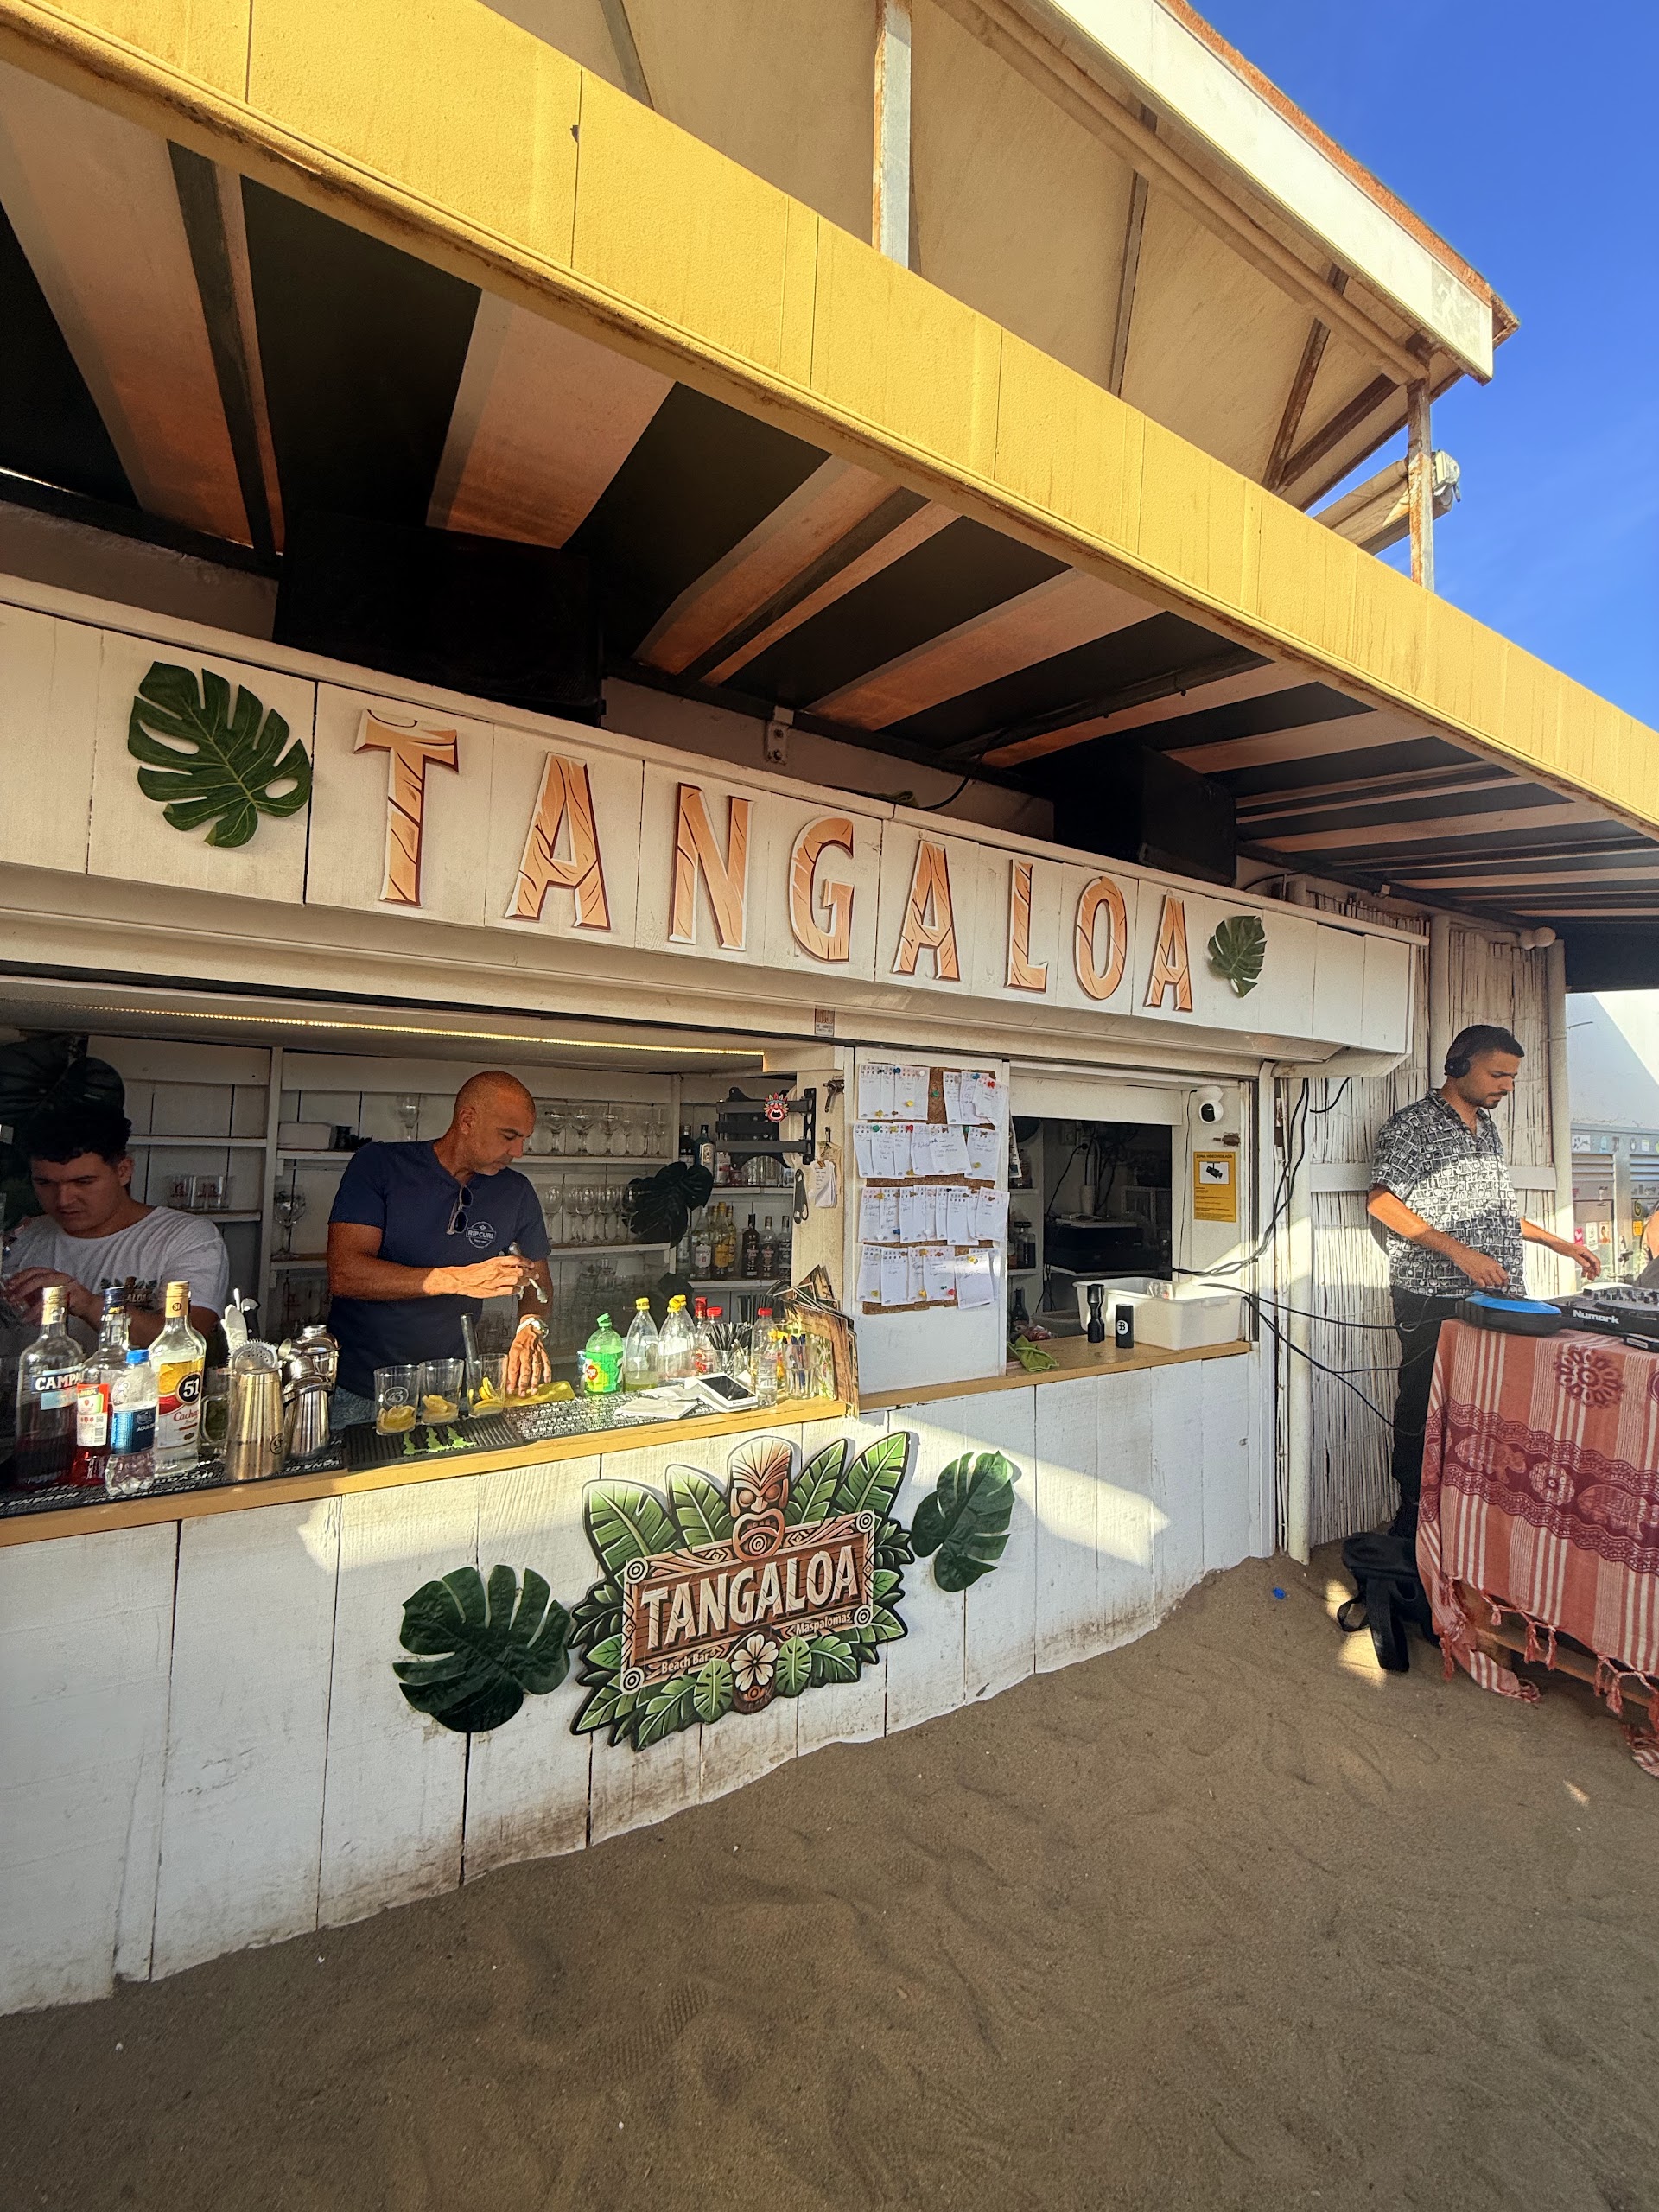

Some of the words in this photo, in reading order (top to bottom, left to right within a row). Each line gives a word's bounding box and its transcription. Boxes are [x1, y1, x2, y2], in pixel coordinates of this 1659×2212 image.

[354, 709, 1193, 1013] TANGALOA
[1573, 1309, 1620, 1324] Numark
[182, 1377, 200, 1398] 51
[641, 1545, 860, 1651] TANGALOA
[796, 1611, 852, 1636] Maspalomas
[661, 1656, 690, 1675] Beach
[692, 1652, 709, 1666] Bar
